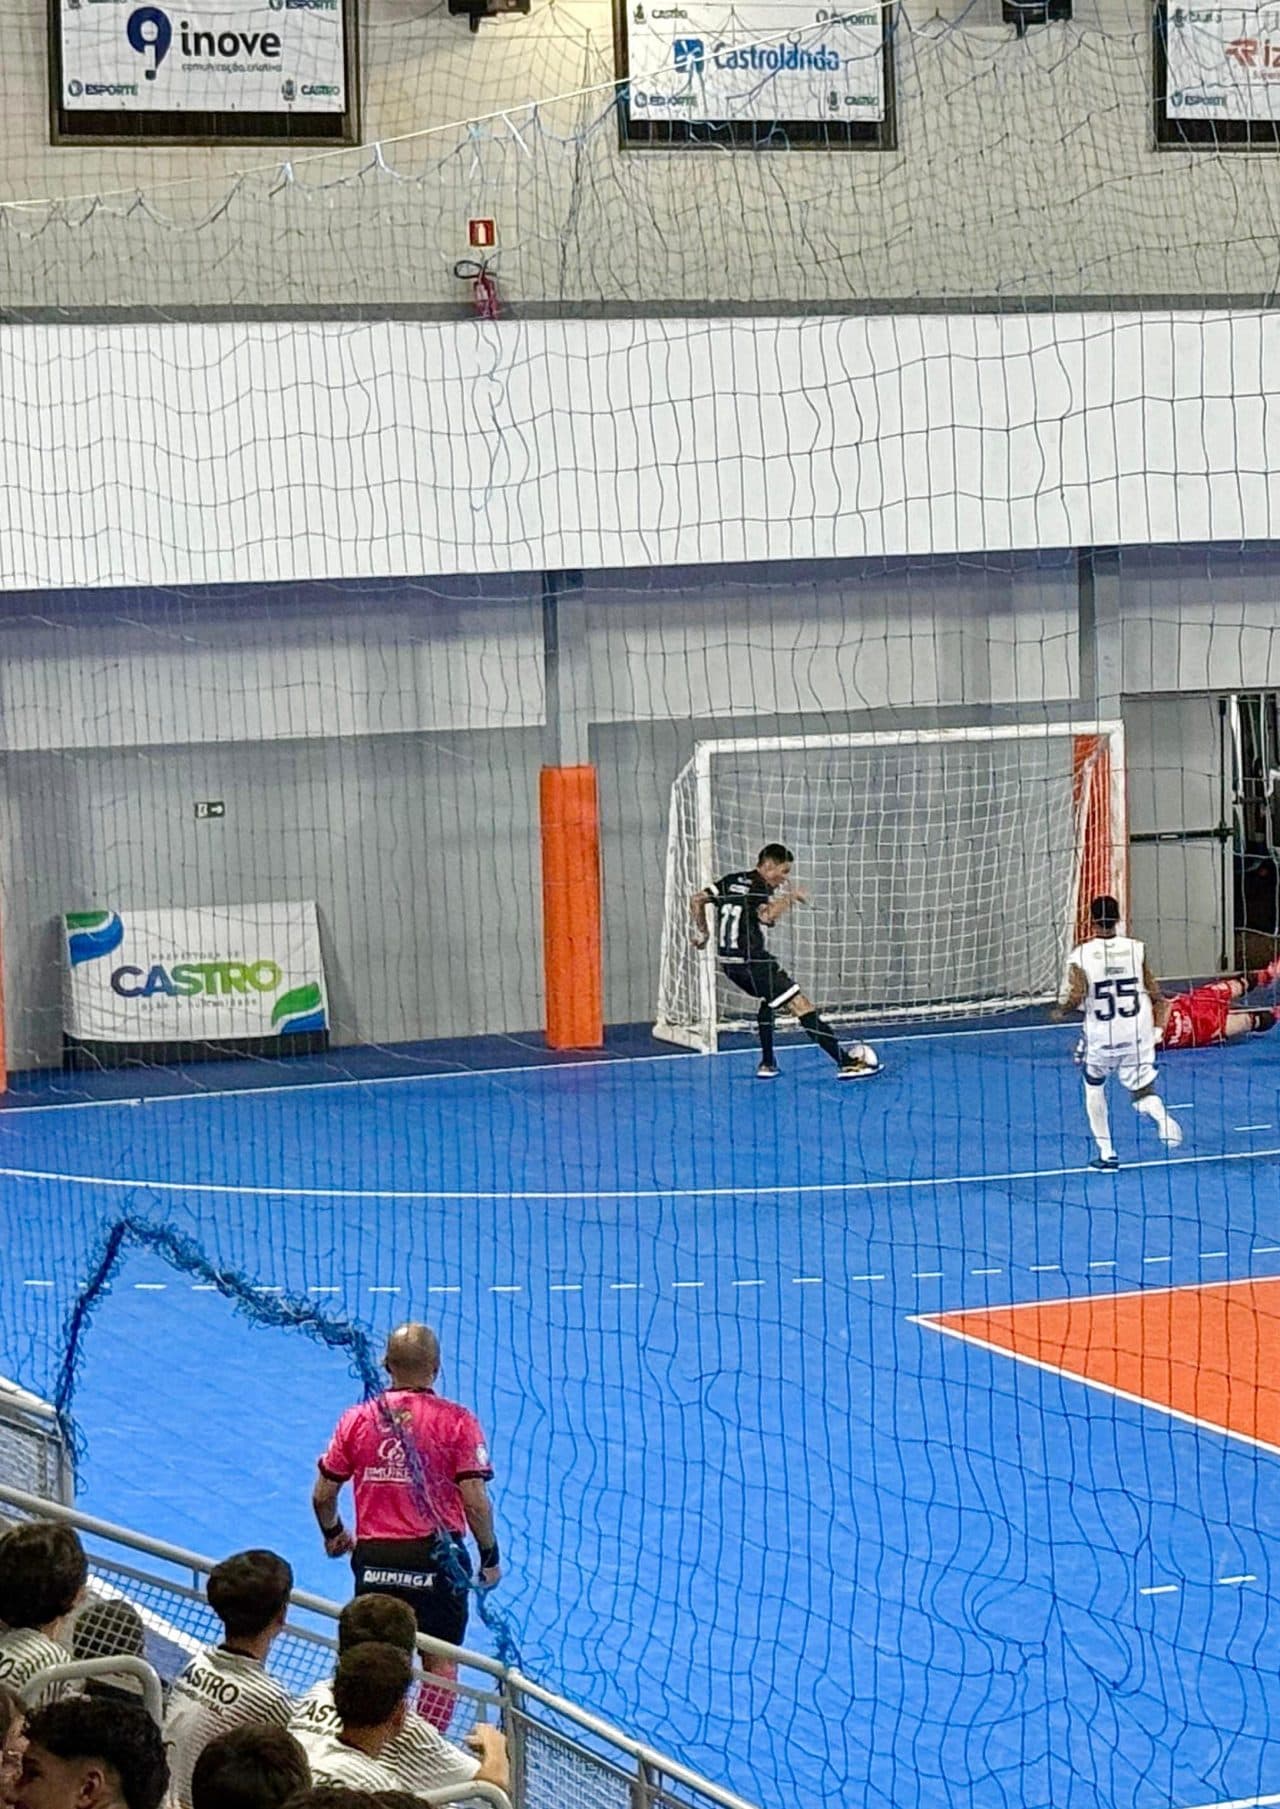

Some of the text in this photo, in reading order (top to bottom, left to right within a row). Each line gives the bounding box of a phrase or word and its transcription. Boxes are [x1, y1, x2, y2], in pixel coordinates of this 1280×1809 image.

[181, 21, 281, 57] inove
[714, 42, 839, 71] Castrolanda
[85, 85, 138, 96] ESPORTE
[720, 903, 743, 949] 11
[110, 959, 283, 998] CASTRO
[1093, 977, 1141, 1021] 55
